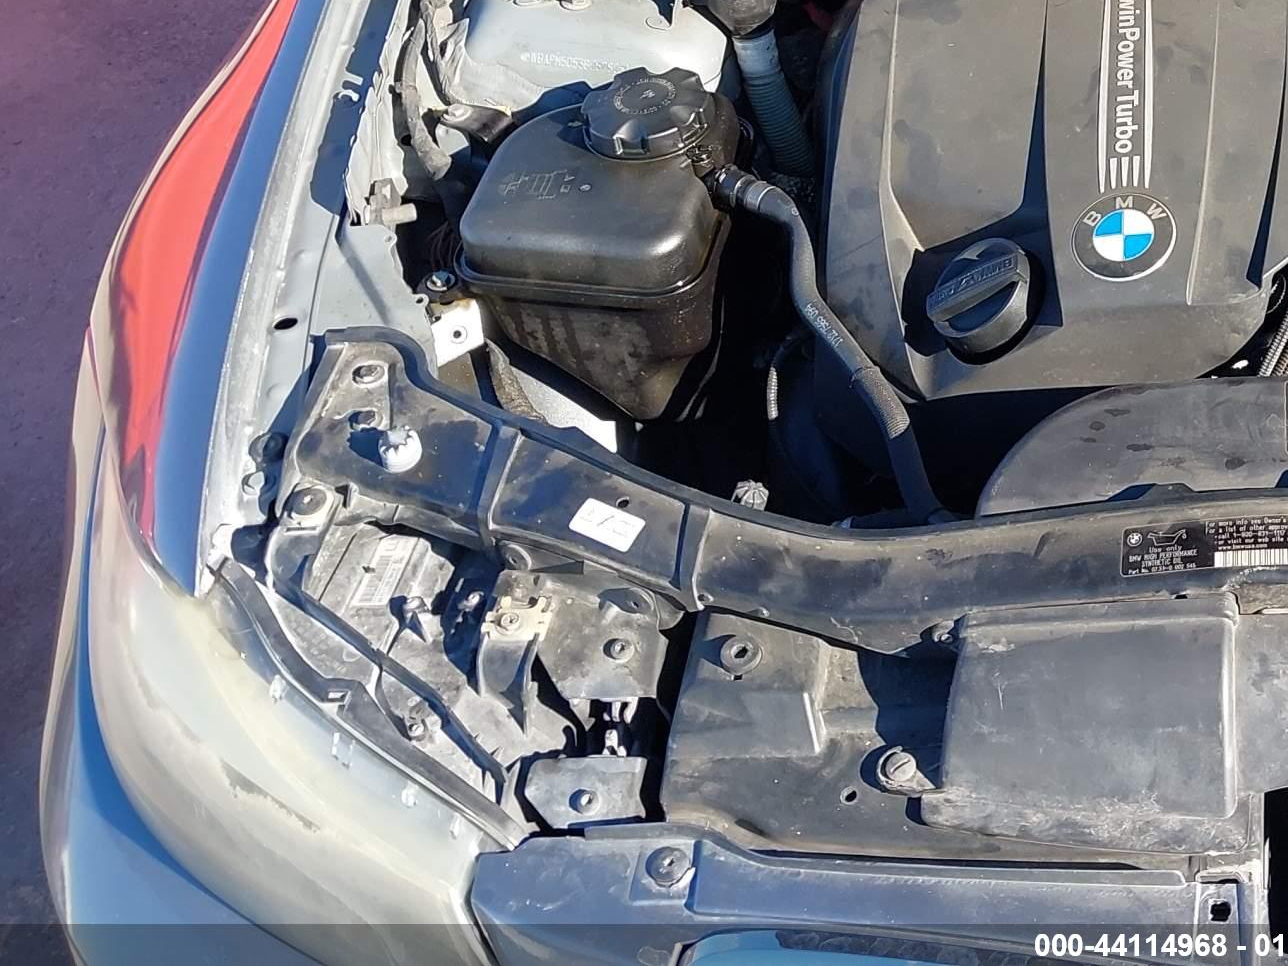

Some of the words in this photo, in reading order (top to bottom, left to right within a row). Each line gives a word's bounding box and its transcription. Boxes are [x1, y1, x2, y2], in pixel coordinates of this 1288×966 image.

[1114, 89, 1140, 154] Turbo
[1082, 195, 1168, 227] BMW
[1235, 518, 1249, 526] info
[1264, 516, 1287, 524] Owner's
[1128, 555, 1141, 563] BMW
[1159, 550, 1197, 559] PERFORMANCE
